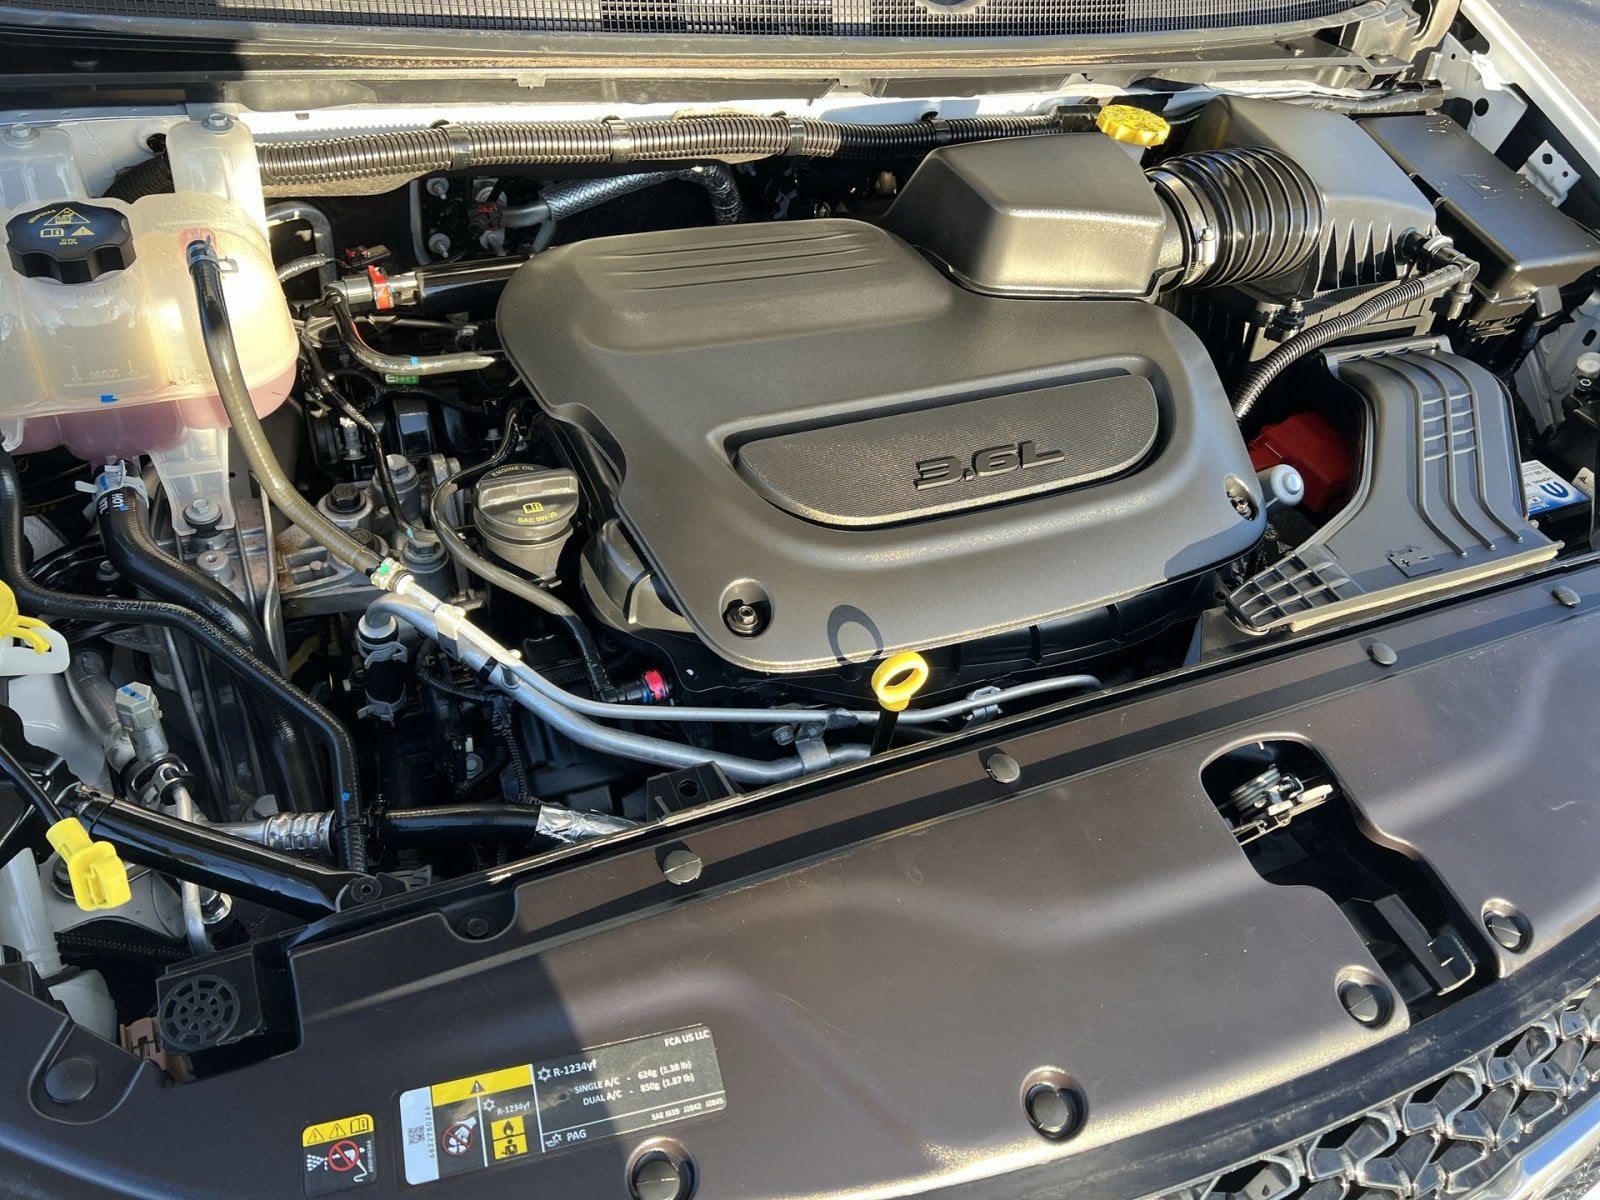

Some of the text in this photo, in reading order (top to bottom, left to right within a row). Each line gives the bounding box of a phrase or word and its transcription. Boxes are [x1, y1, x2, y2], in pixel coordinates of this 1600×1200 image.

[491, 465, 520, 477] ENGINE
[913, 440, 1066, 490] 3.6L
[111, 493, 124, 508] HOT
[535, 511, 558, 522] 0W-20
[664, 1029, 711, 1048] FCA US LLC
[553, 1059, 597, 1077] R-1234yf
[574, 1081, 603, 1095] SINGLE
[603, 1077, 621, 1089] A/C
[637, 1068, 658, 1080] 624g
[660, 1063, 680, 1076] (1.38
[680, 1059, 693, 1071] lb)
[582, 1095, 606, 1106] DUAL
[606, 1090, 623, 1101] A/C
[640, 1081, 661, 1093] 850g
[662, 1076, 682, 1089] (1.87
[682, 1073, 695, 1084] lb)
[496, 1101, 531, 1116] R-1234yf
[651, 1111, 664, 1121] SAE
[566, 1129, 587, 1142] PAG
